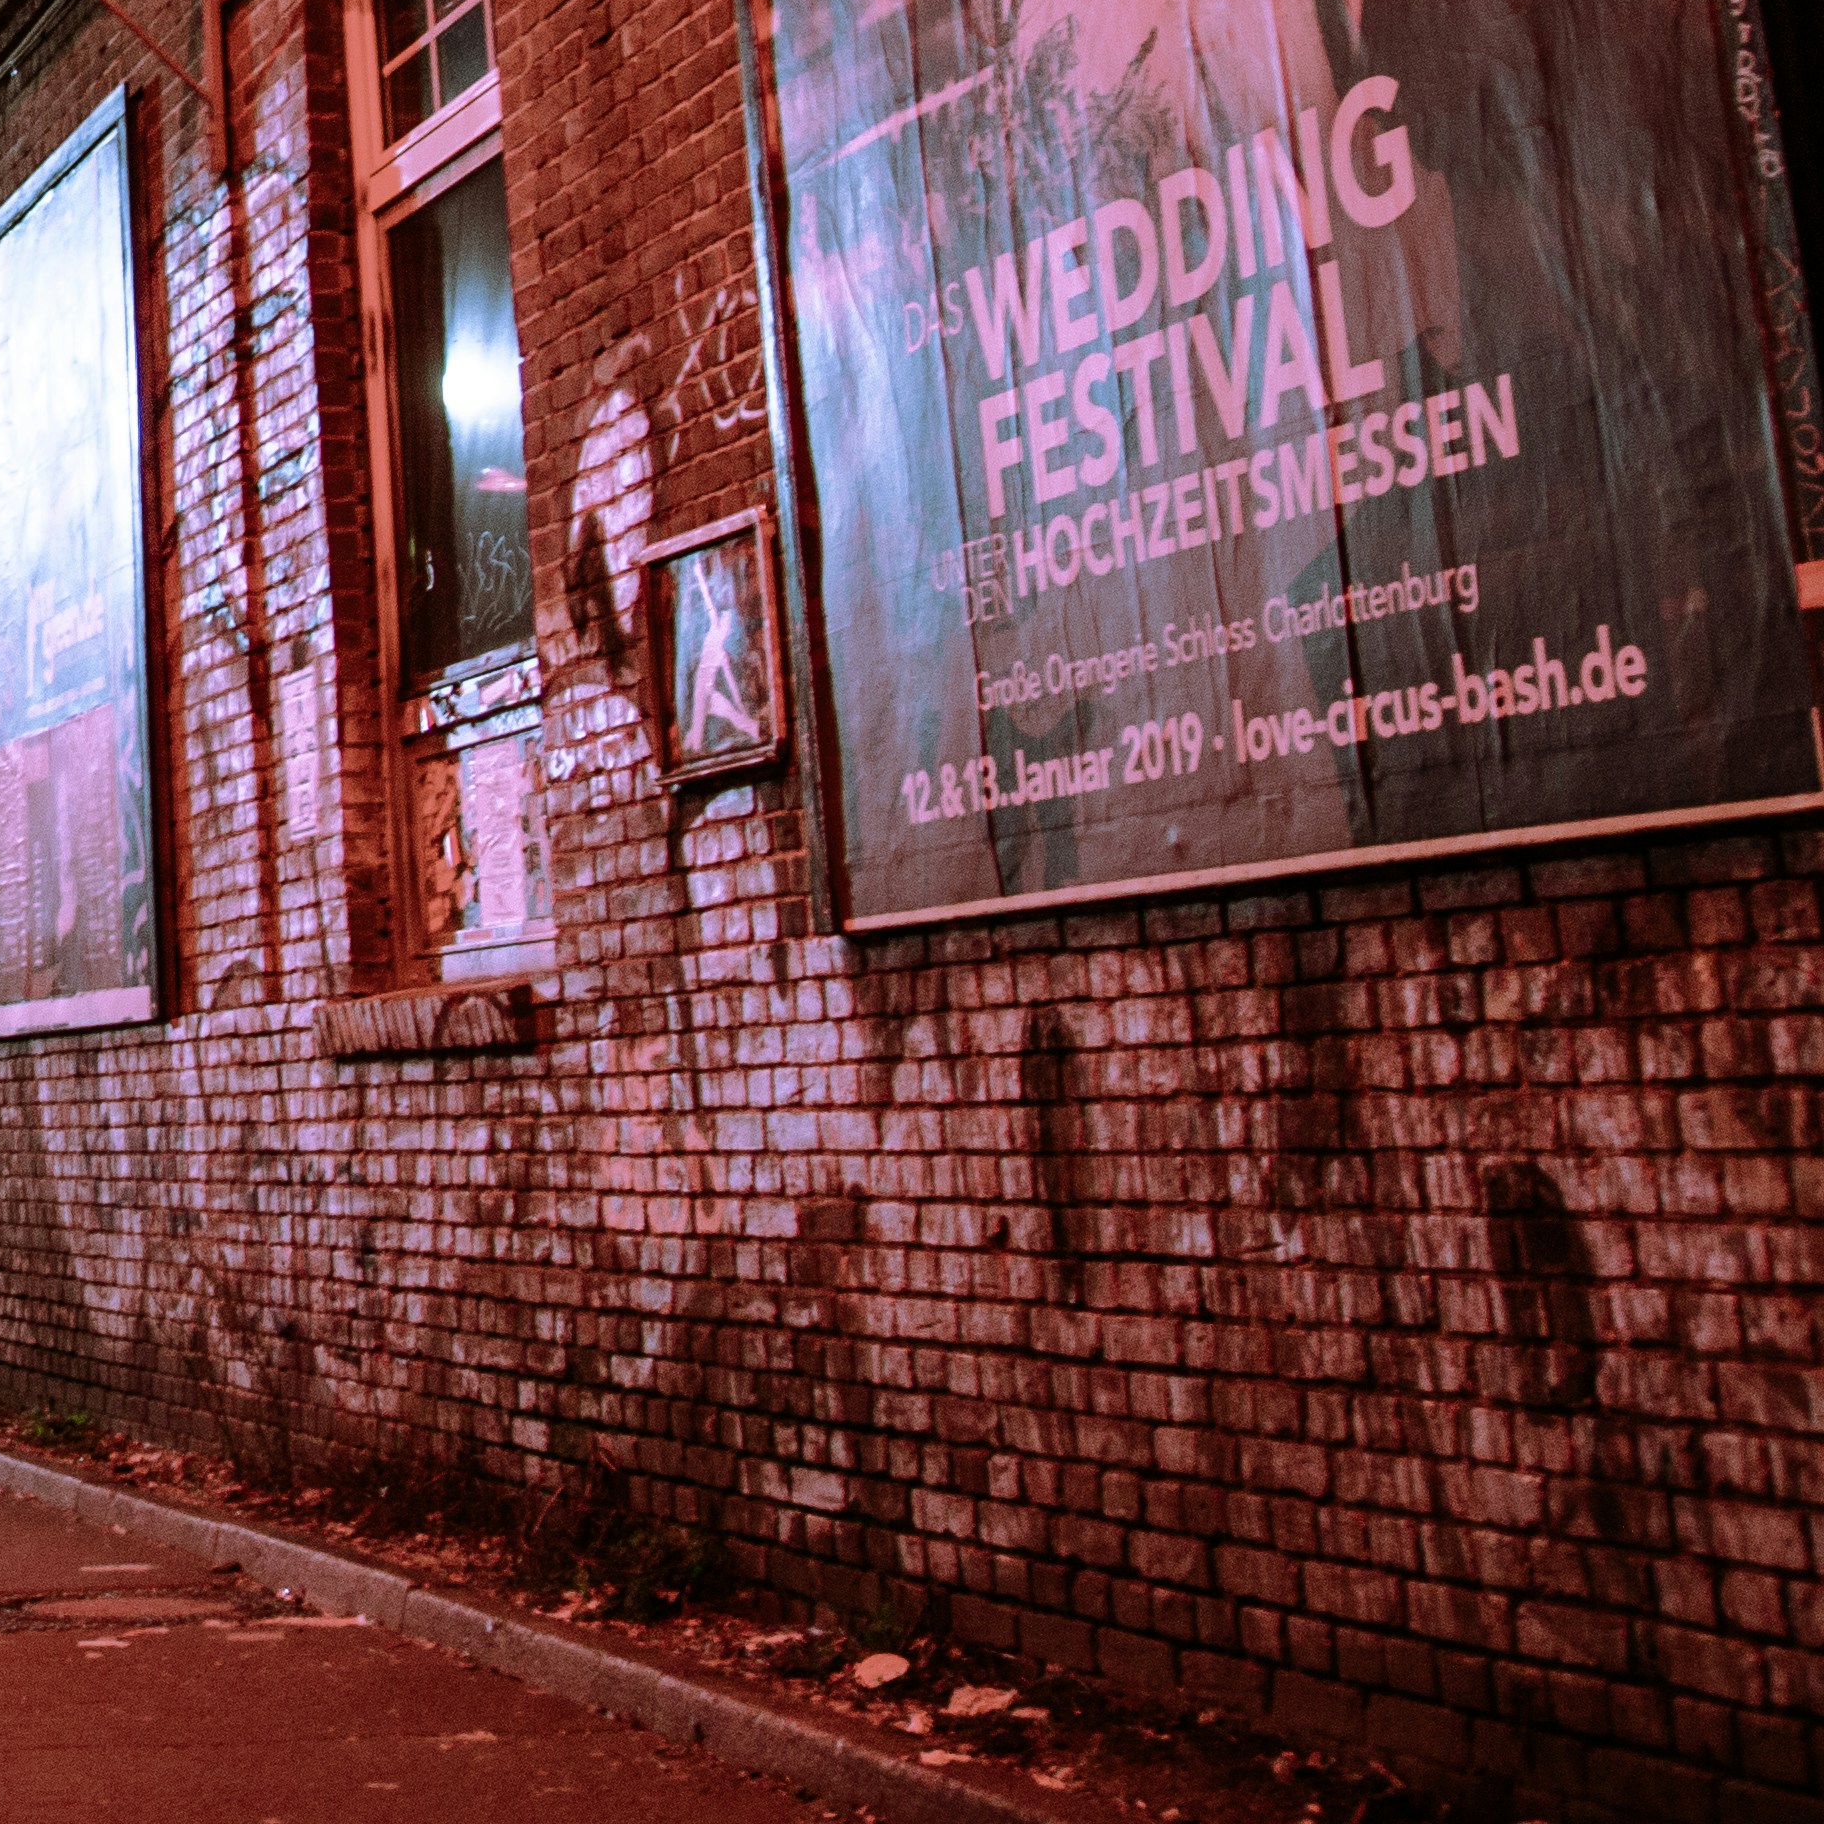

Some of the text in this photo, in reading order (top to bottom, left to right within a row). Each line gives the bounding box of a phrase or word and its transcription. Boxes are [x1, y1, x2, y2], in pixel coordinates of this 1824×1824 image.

[902, 282, 965, 355] DAS
[964, 75, 1416, 381] WEDDING
[979, 262, 1385, 519] FESTIVAL
[931, 533, 1010, 594] UNTER
[960, 374, 1520, 627] DEN HOCHZEITSMESSEN
[977, 563, 1480, 712] Große Orangerie Schloss Charlottenburg
[1121, 711, 1202, 784] 2019
[1232, 623, 1649, 766] love-circus-bash.de
